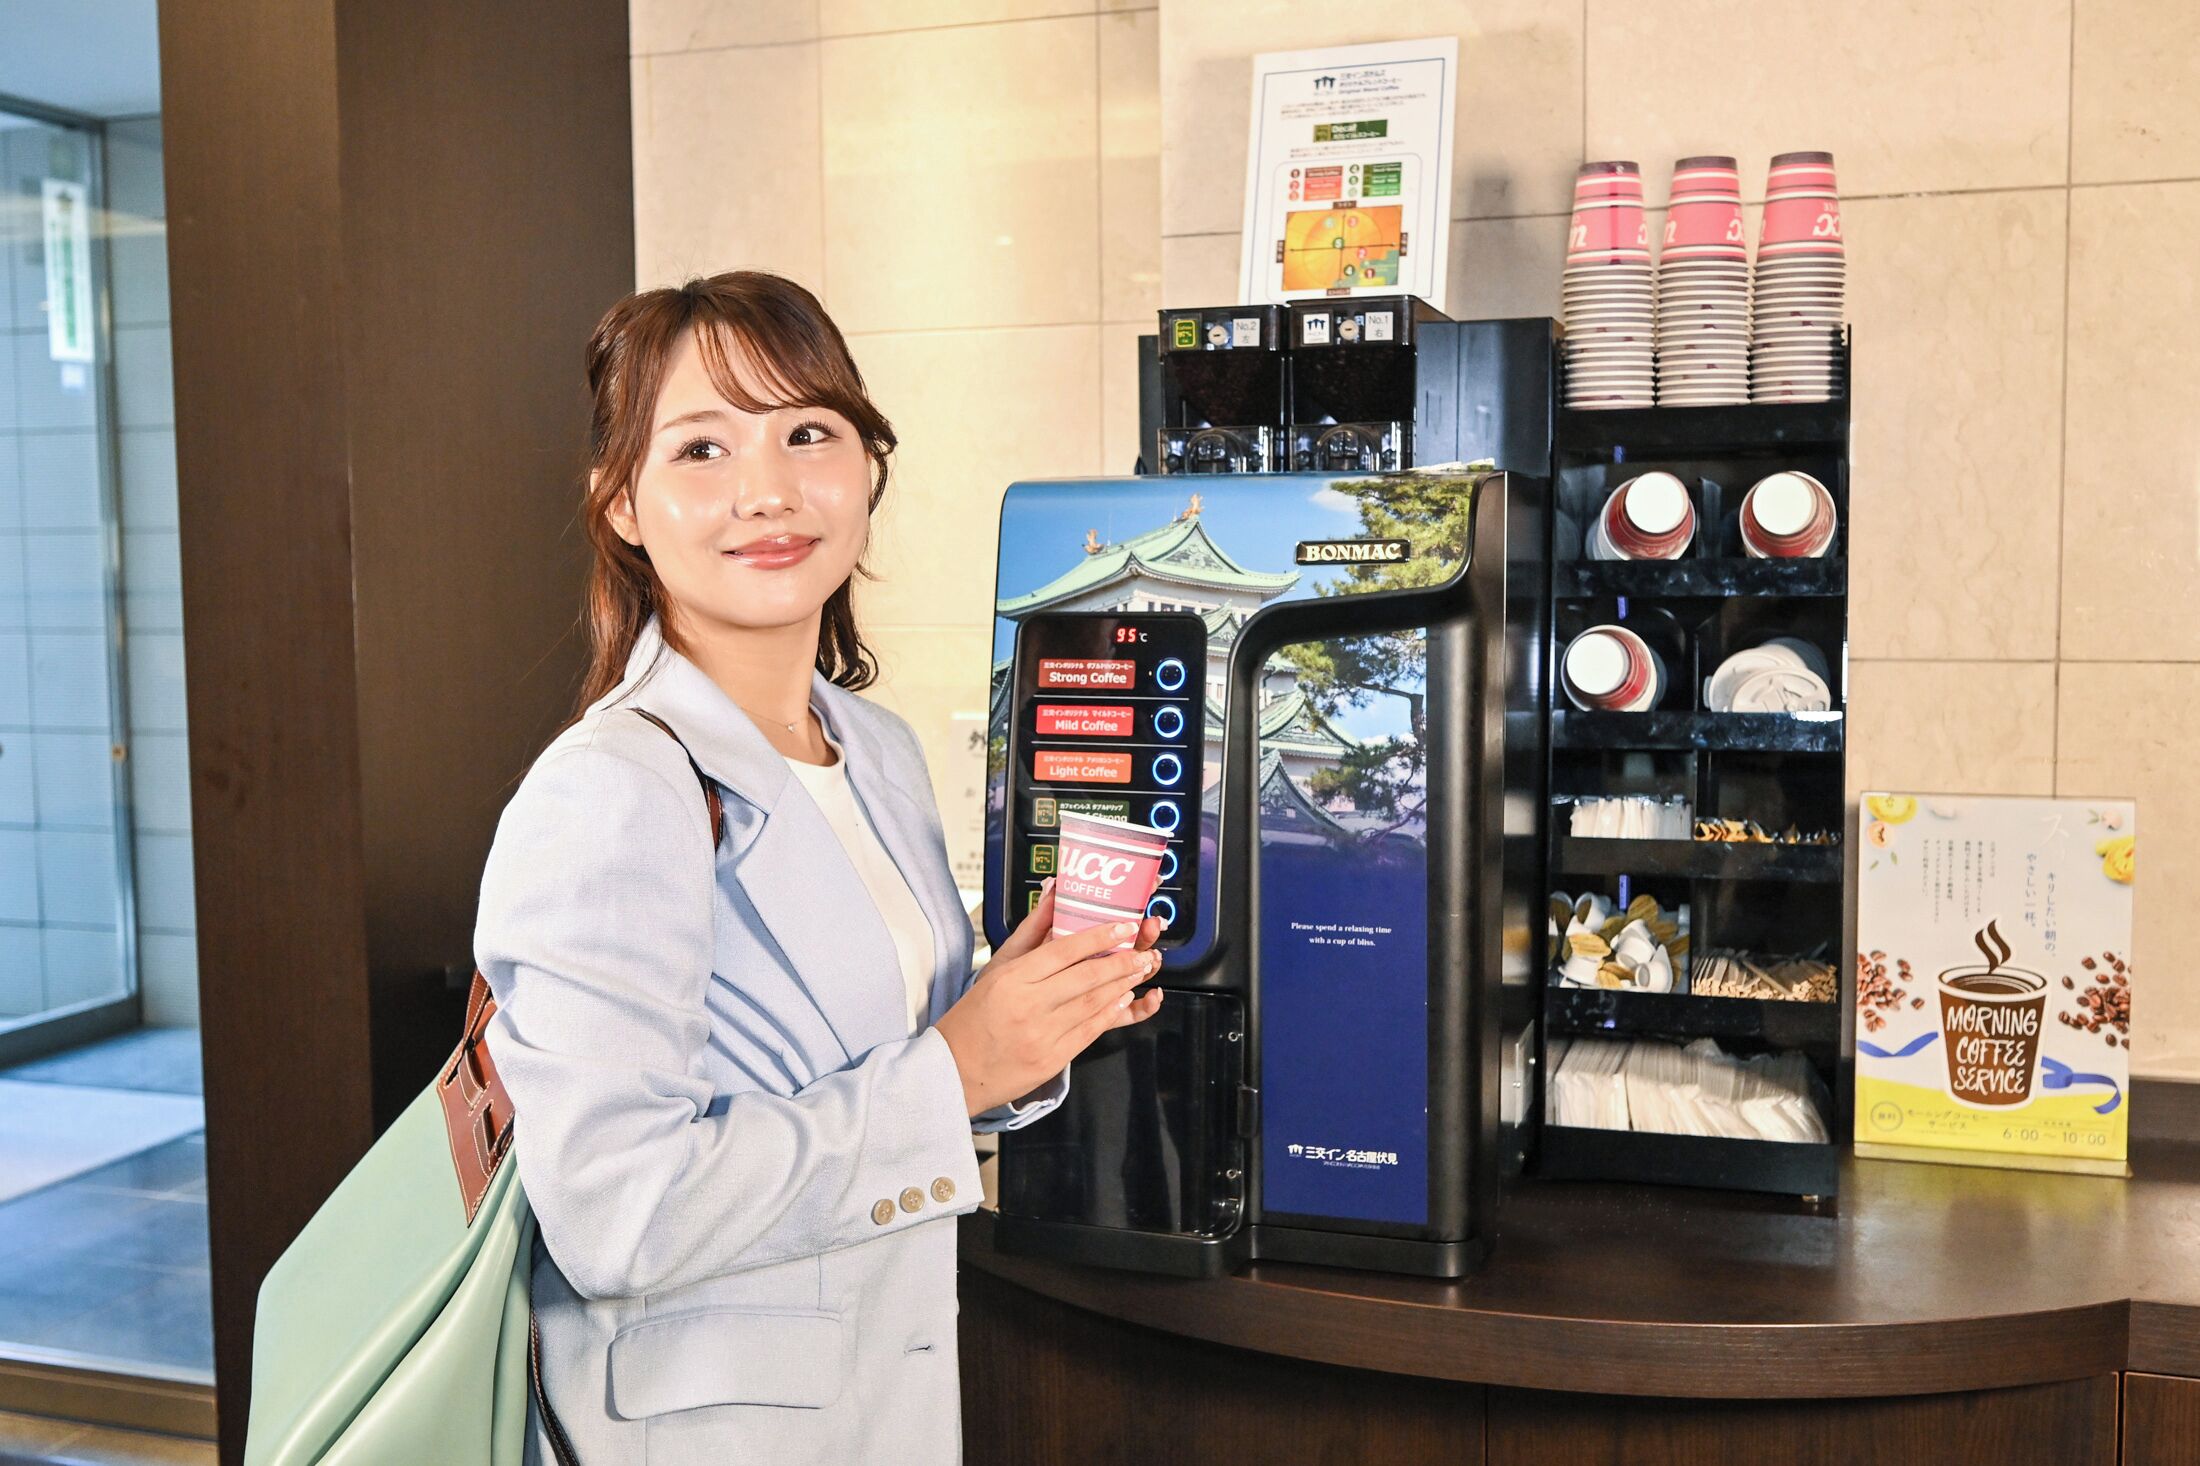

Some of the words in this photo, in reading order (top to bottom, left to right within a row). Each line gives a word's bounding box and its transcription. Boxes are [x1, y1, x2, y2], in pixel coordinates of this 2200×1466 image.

[1235, 321, 1257, 332] No.2
[1368, 315, 1389, 325] No.1
[1305, 543, 1402, 561] BONMAC
[1117, 628, 1136, 643] 95
[1049, 671, 1087, 685] Strong
[1090, 673, 1127, 684] Coffee
[1055, 720, 1079, 731] Mild
[1081, 721, 1118, 732] Coffee
[1049, 765, 1078, 778] Light
[1081, 766, 1118, 778] Coffee
[1063, 881, 1113, 900] COFFEE
[1291, 922, 1314, 930] Please
[1315, 924, 1337, 933] spend
[1344, 925, 1374, 934] relaxing
[1332, 938, 1346, 947] cup
[1357, 938, 1376, 946] bliss.
[1946, 1004, 2038, 1037] MORNING
[1956, 1036, 2026, 1067] COFFEE
[1954, 1066, 2025, 1095] SERVICE
